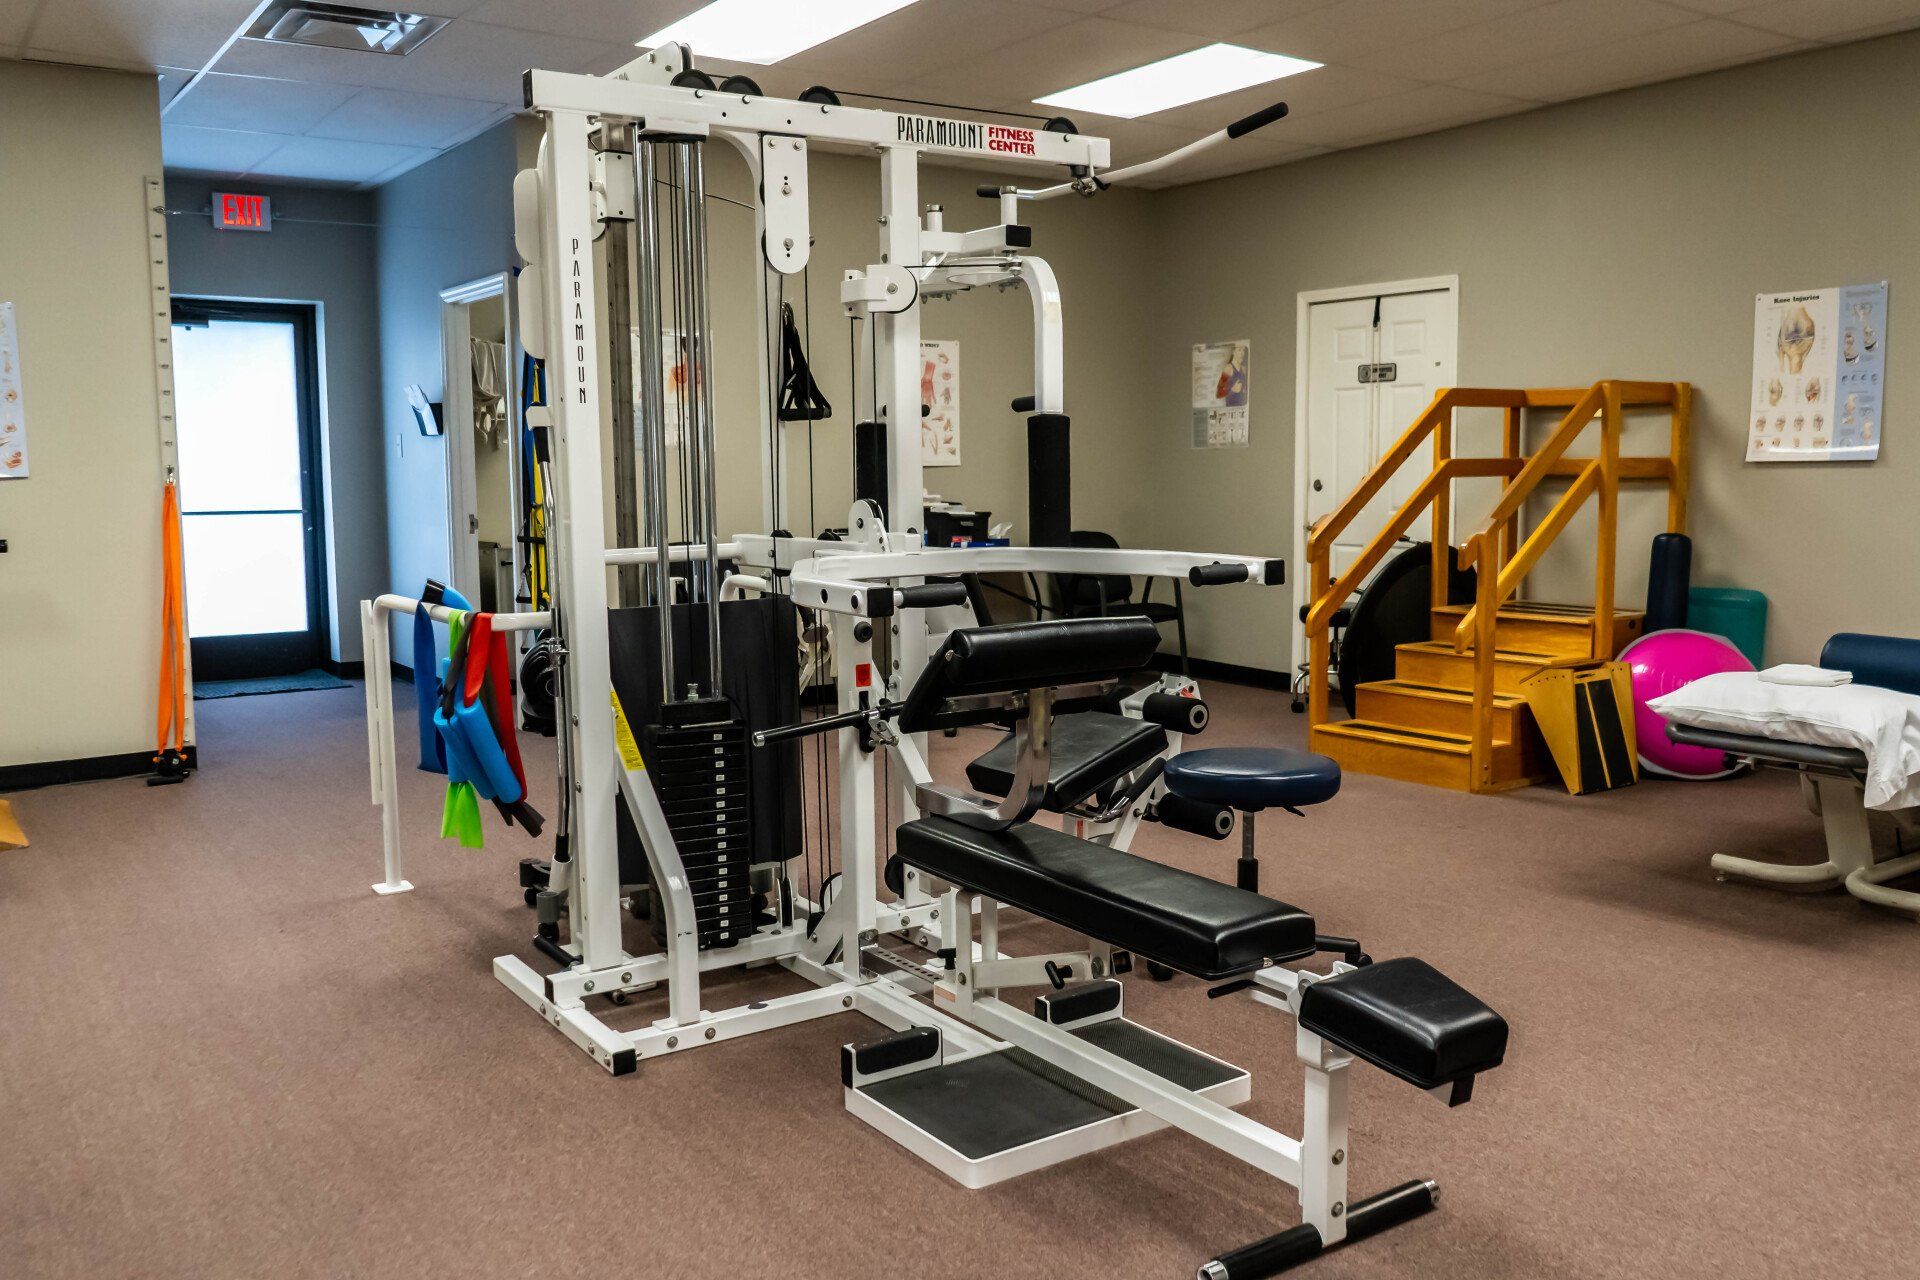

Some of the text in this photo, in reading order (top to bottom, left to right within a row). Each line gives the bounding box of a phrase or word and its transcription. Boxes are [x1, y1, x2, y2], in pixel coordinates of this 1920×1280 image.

[898, 115, 984, 149] PARAMOUNT
[988, 126, 1035, 143] FITNESS
[988, 139, 1036, 155] CENTER
[223, 193, 263, 227] EXIT
[572, 238, 587, 403] PARAMOUN
